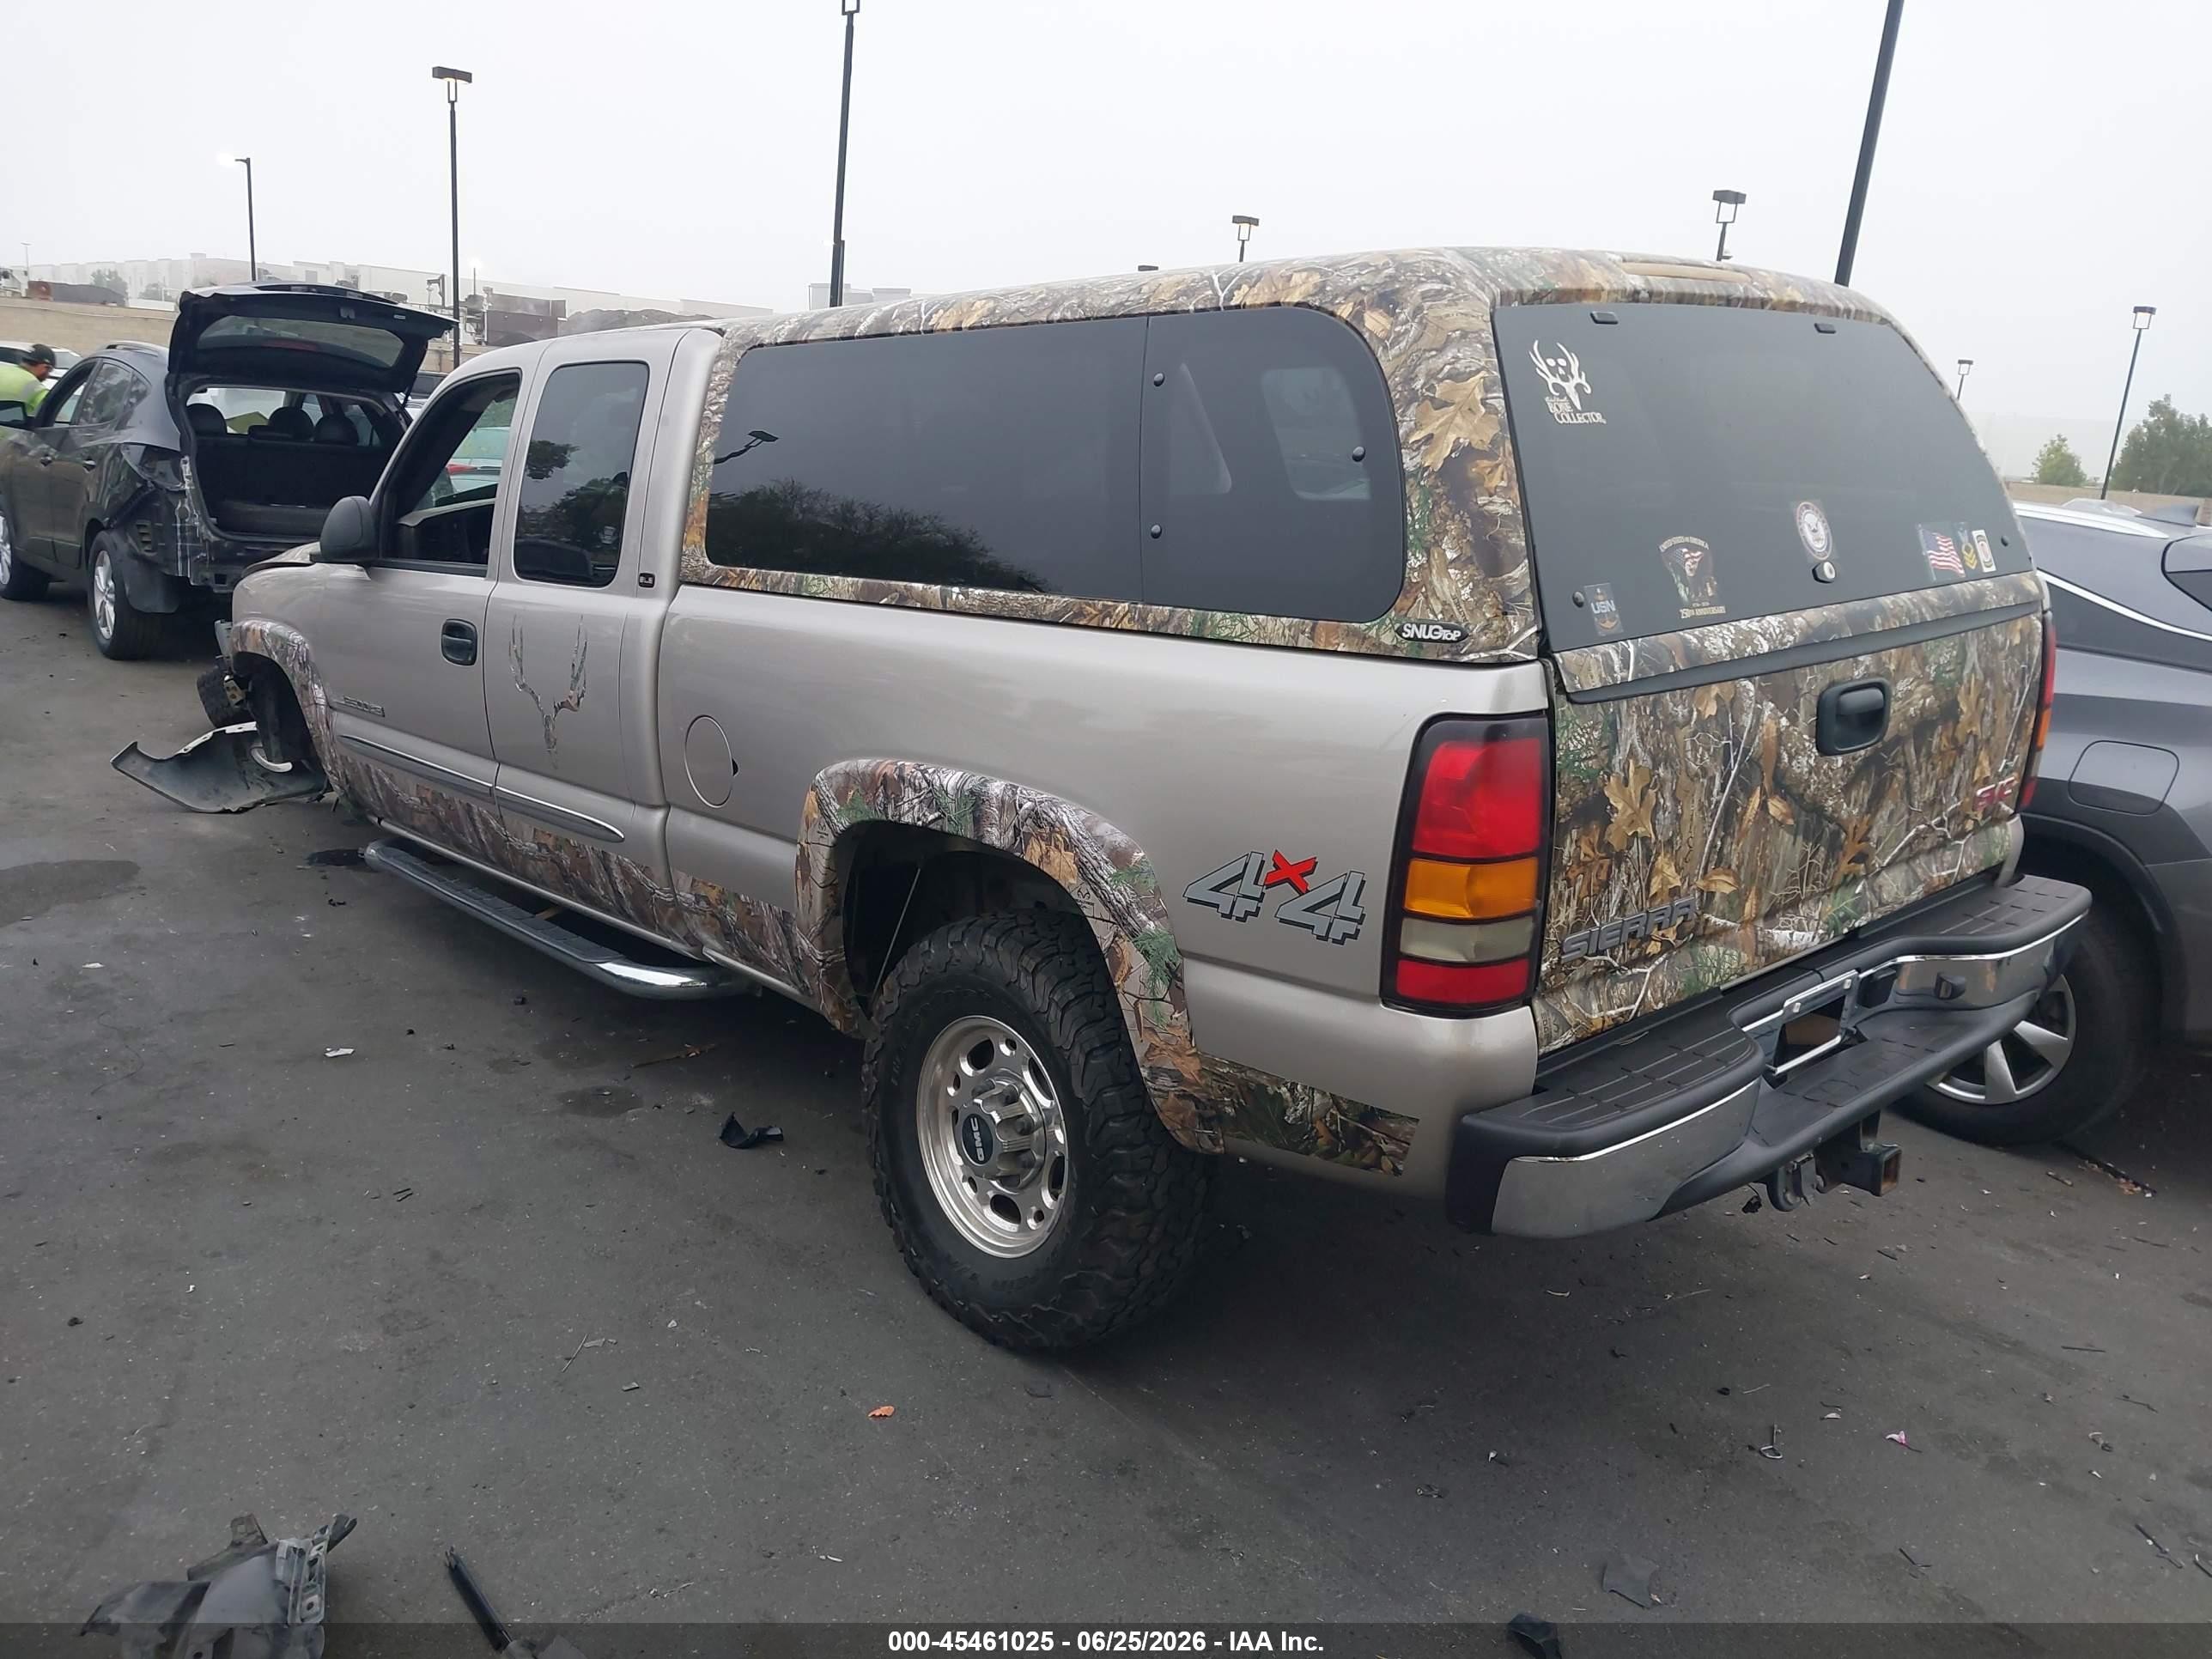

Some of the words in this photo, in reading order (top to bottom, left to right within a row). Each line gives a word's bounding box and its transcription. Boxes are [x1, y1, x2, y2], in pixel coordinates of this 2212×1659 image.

[1590, 599, 1616, 614] USN
[1560, 896, 1697, 963] SIERRA
[970, 1117, 985, 1162] GMC
